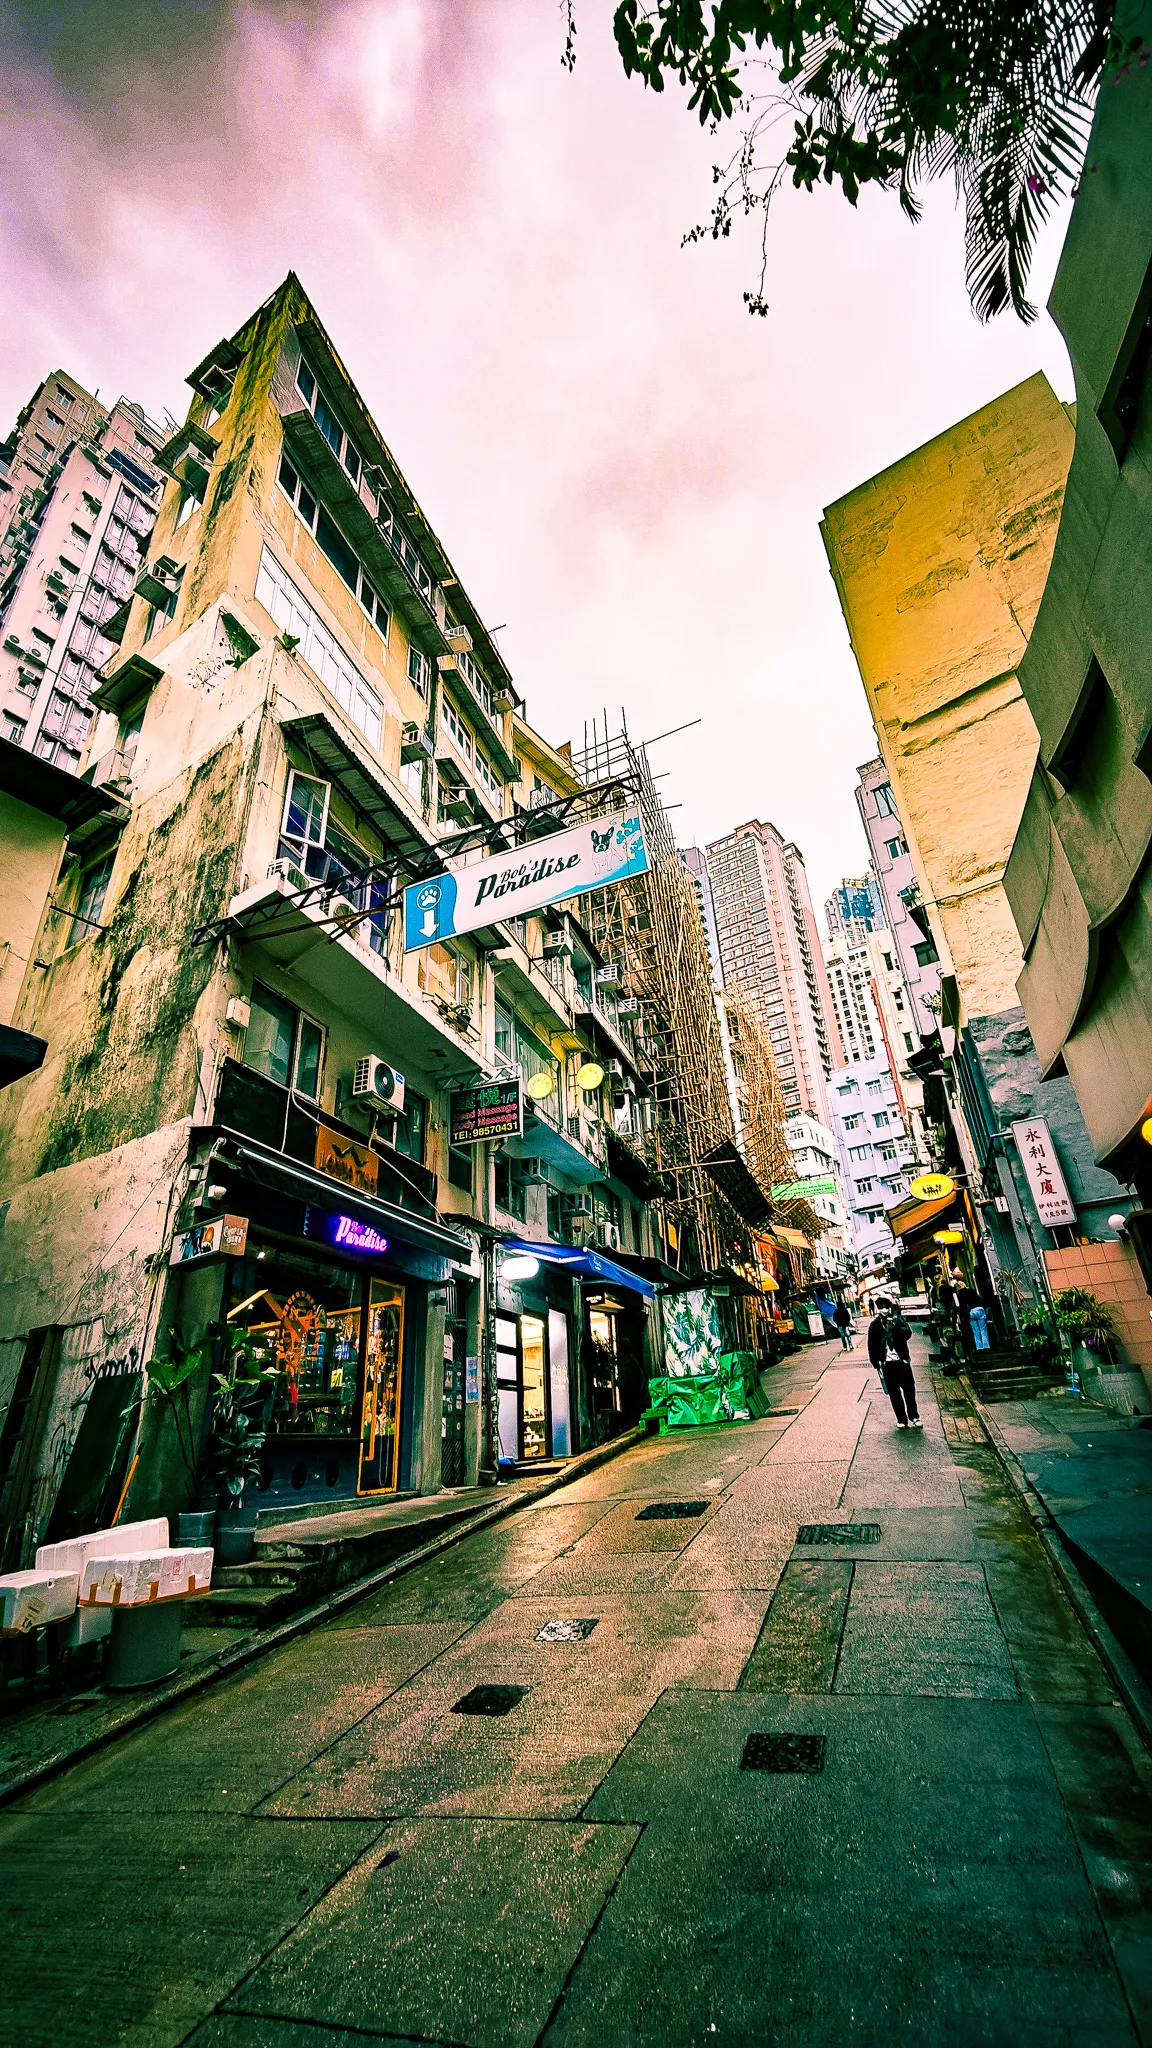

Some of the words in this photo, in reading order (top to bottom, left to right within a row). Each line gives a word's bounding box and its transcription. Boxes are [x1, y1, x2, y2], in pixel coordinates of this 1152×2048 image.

[474, 854, 581, 907] Paradise
[501, 860, 538, 883] Bob's
[501, 1092, 517, 1104] 1/F
[477, 1103, 518, 1117] Massage
[335, 1215, 388, 1252] Paradise
